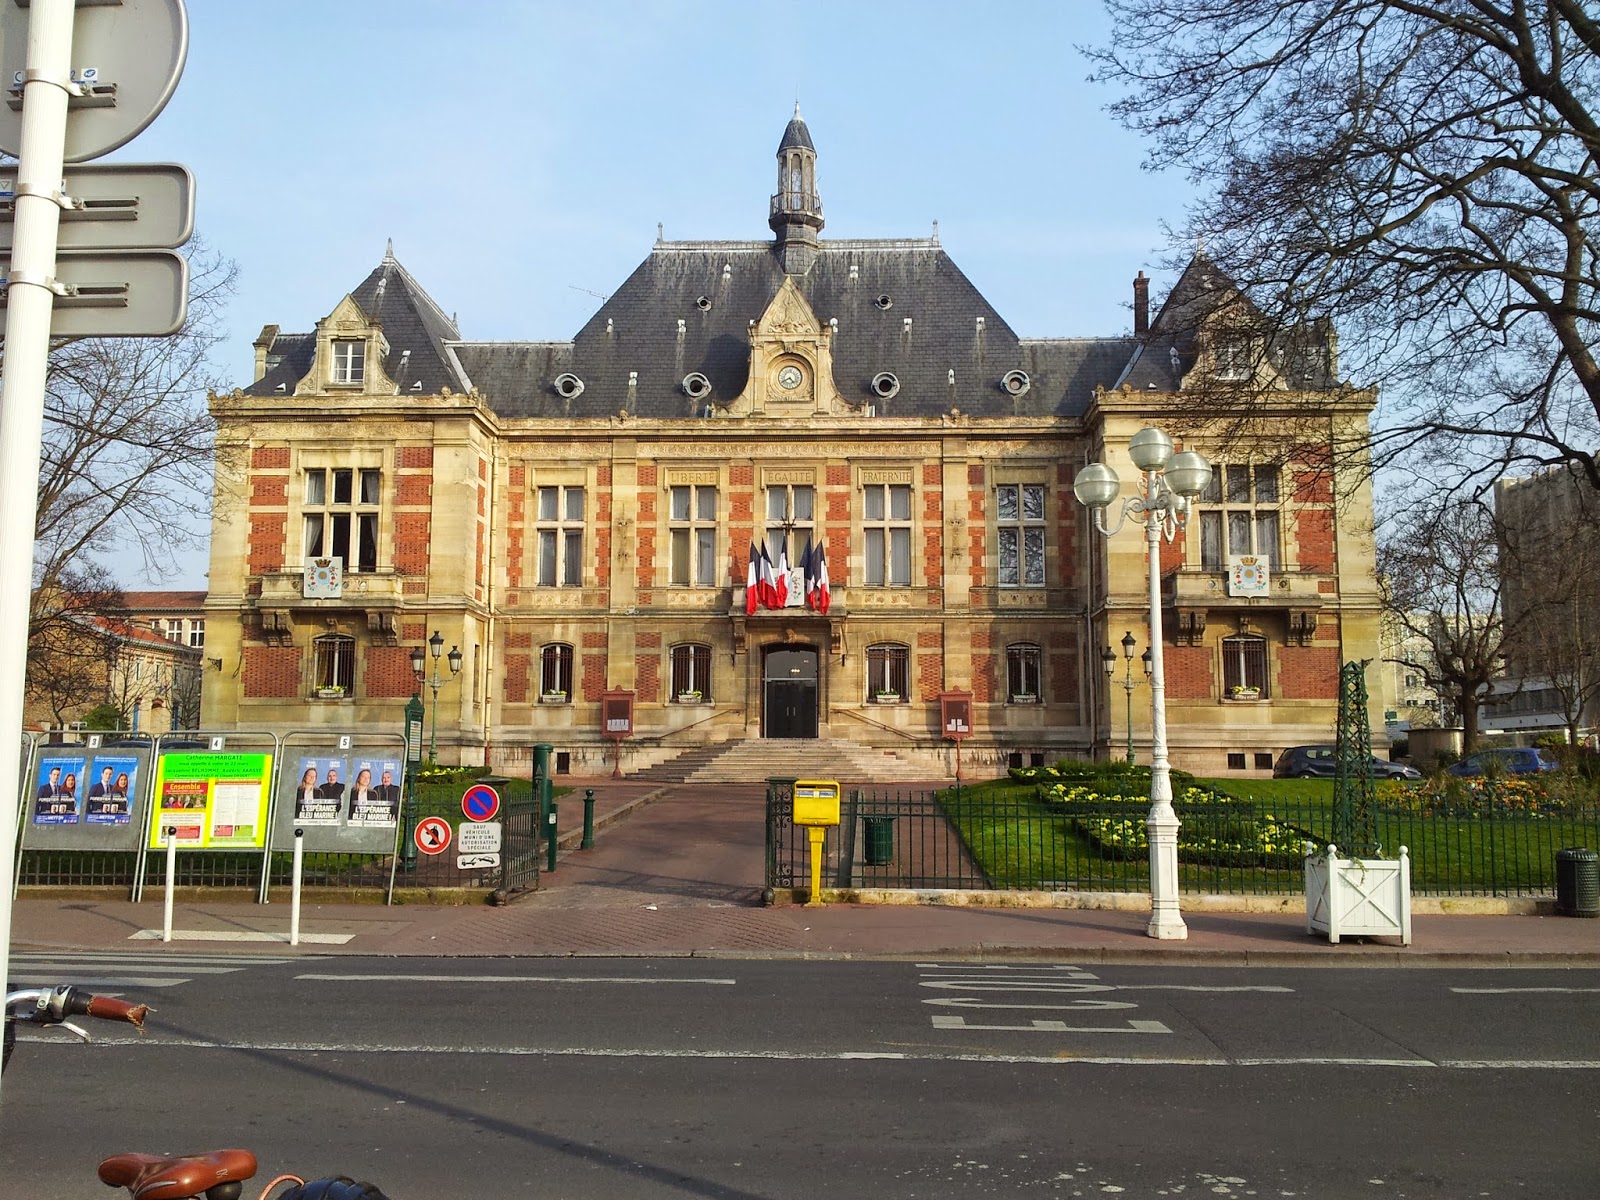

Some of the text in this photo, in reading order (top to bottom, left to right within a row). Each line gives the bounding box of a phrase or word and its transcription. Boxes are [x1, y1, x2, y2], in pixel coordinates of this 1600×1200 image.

[301, 804, 337, 812] L'ESPÉRANCE
[355, 805, 391, 813] L'ESPÉRANCE
[299, 811, 313, 819] BLEU
[313, 811, 335, 819] MARINE
[352, 812, 367, 820] BLEU
[367, 812, 389, 821] MARINE
